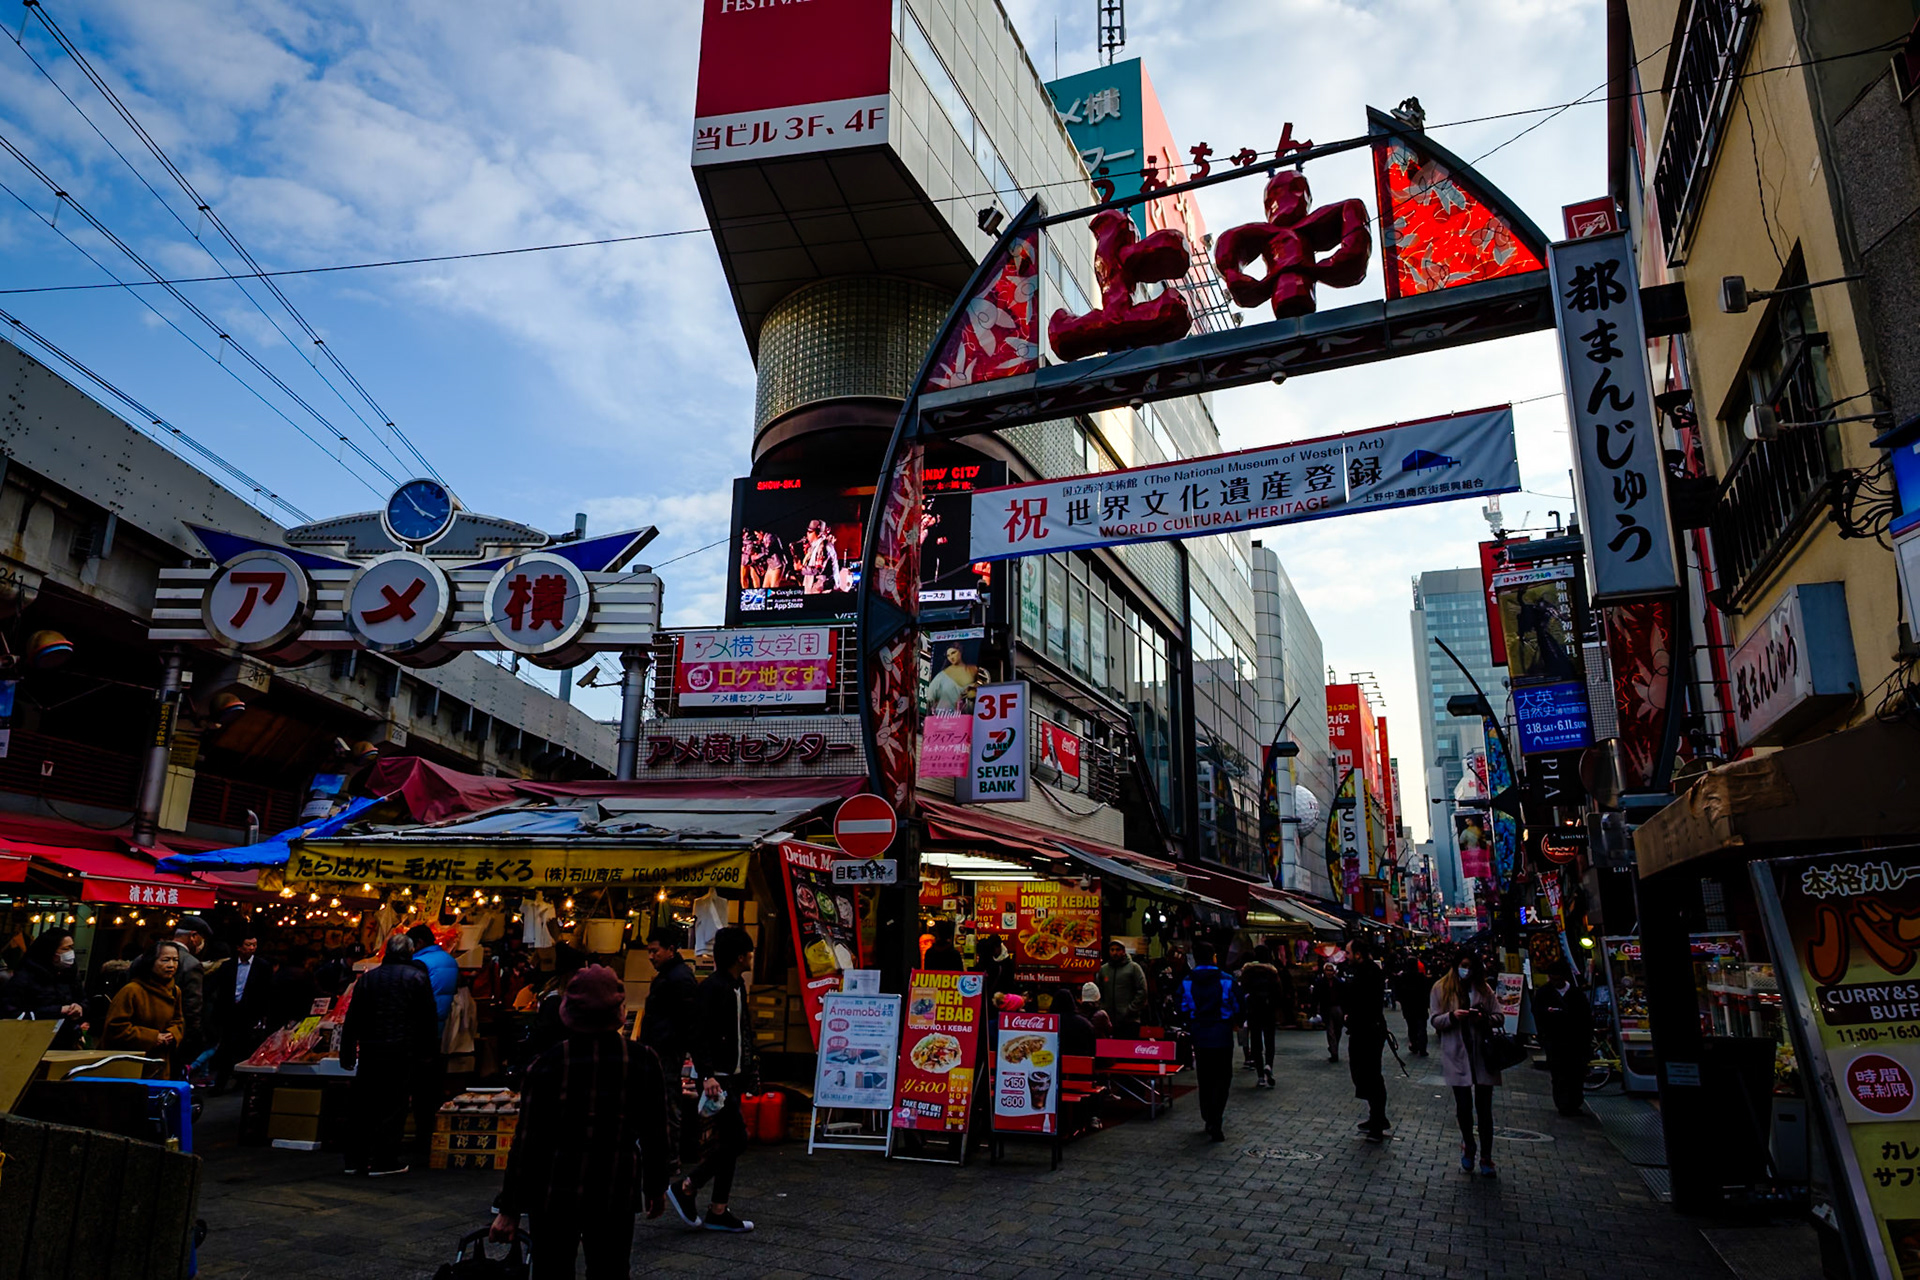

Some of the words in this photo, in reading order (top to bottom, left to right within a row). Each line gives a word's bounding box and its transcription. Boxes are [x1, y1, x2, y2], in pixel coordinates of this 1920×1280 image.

[721, 0, 815, 13] FESTI
[695, 121, 778, 151] 当ビル
[1564, 258, 1653, 563] 都まんじゅう
[1174, 462, 1225, 481] National
[1228, 457, 1279, 475] Museum
[1282, 452, 1296, 464] of
[1358, 437, 1385, 452] Art)
[951, 464, 980, 480] CITY
[1065, 455, 1383, 527] 世界文化遺産登録
[1002, 497, 1049, 543] 祝
[1099, 521, 1157, 538] WORLD
[1163, 509, 1243, 532] CULTURAL
[1249, 495, 1331, 520] HERITAGE
[230, 571, 568, 632] アメ横
[694, 633, 820, 659] アメ横女学園
[718, 665, 819, 687] ロケ地です
[711, 693, 794, 703] アメ横センタービル
[977, 693, 1018, 721] 3F
[645, 732, 856, 765] アメ横センター
[977, 764, 1019, 779] SEVEN
[979, 781, 1016, 793] BANK
[783, 846, 818, 870] Drink
[294, 855, 394, 879] たらばがに
[403, 857, 466, 881] 毛がに
[475, 858, 534, 883] まぐろ
[1021, 881, 1060, 893] JUMBO
[1021, 895, 1058, 908] DONER
[1061, 895, 1099, 908] KEBAB
[936, 990, 963, 1005] NER
[829, 1006, 880, 1017] Amemoba
[936, 1006, 973, 1023] EBAB
[948, 1025, 973, 1033] KEBAB
[1855, 1067, 1902, 1083] 時間
[1873, 1167, 1920, 1187] サフ
